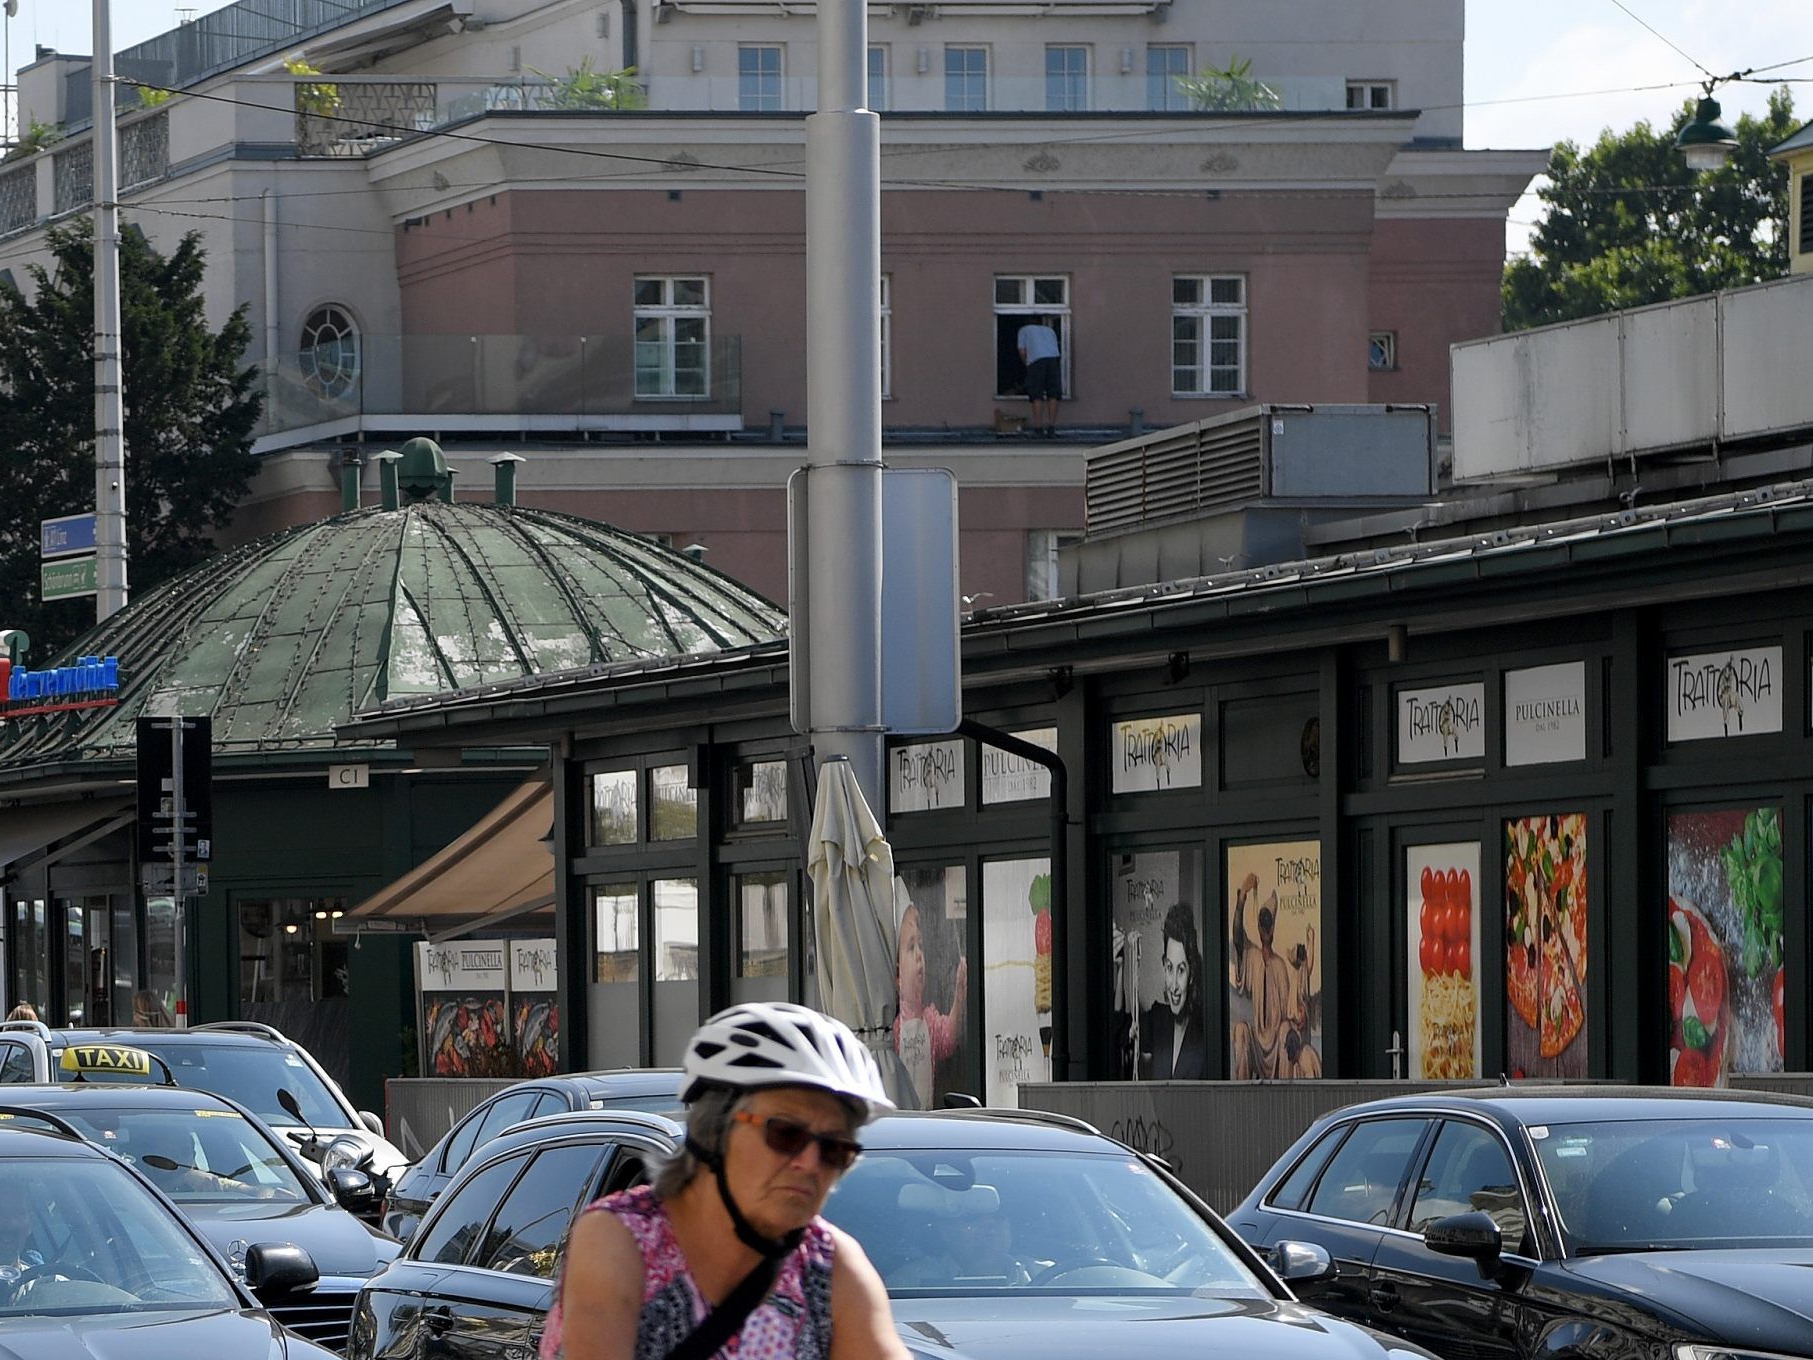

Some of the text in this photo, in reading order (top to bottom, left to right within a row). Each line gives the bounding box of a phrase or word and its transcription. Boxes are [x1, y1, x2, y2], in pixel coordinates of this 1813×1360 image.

[1673, 657, 1771, 717] TRATTORIA
[1406, 697, 1480, 741] TRATTORIA
[1516, 698, 1580, 721] PULCINELLA
[1120, 724, 1190, 772] TRATTORIA
[897, 748, 955, 794] TRATTORIA
[461, 953, 503, 968] PULCINELLA
[79, 1049, 140, 1069] TAXI
